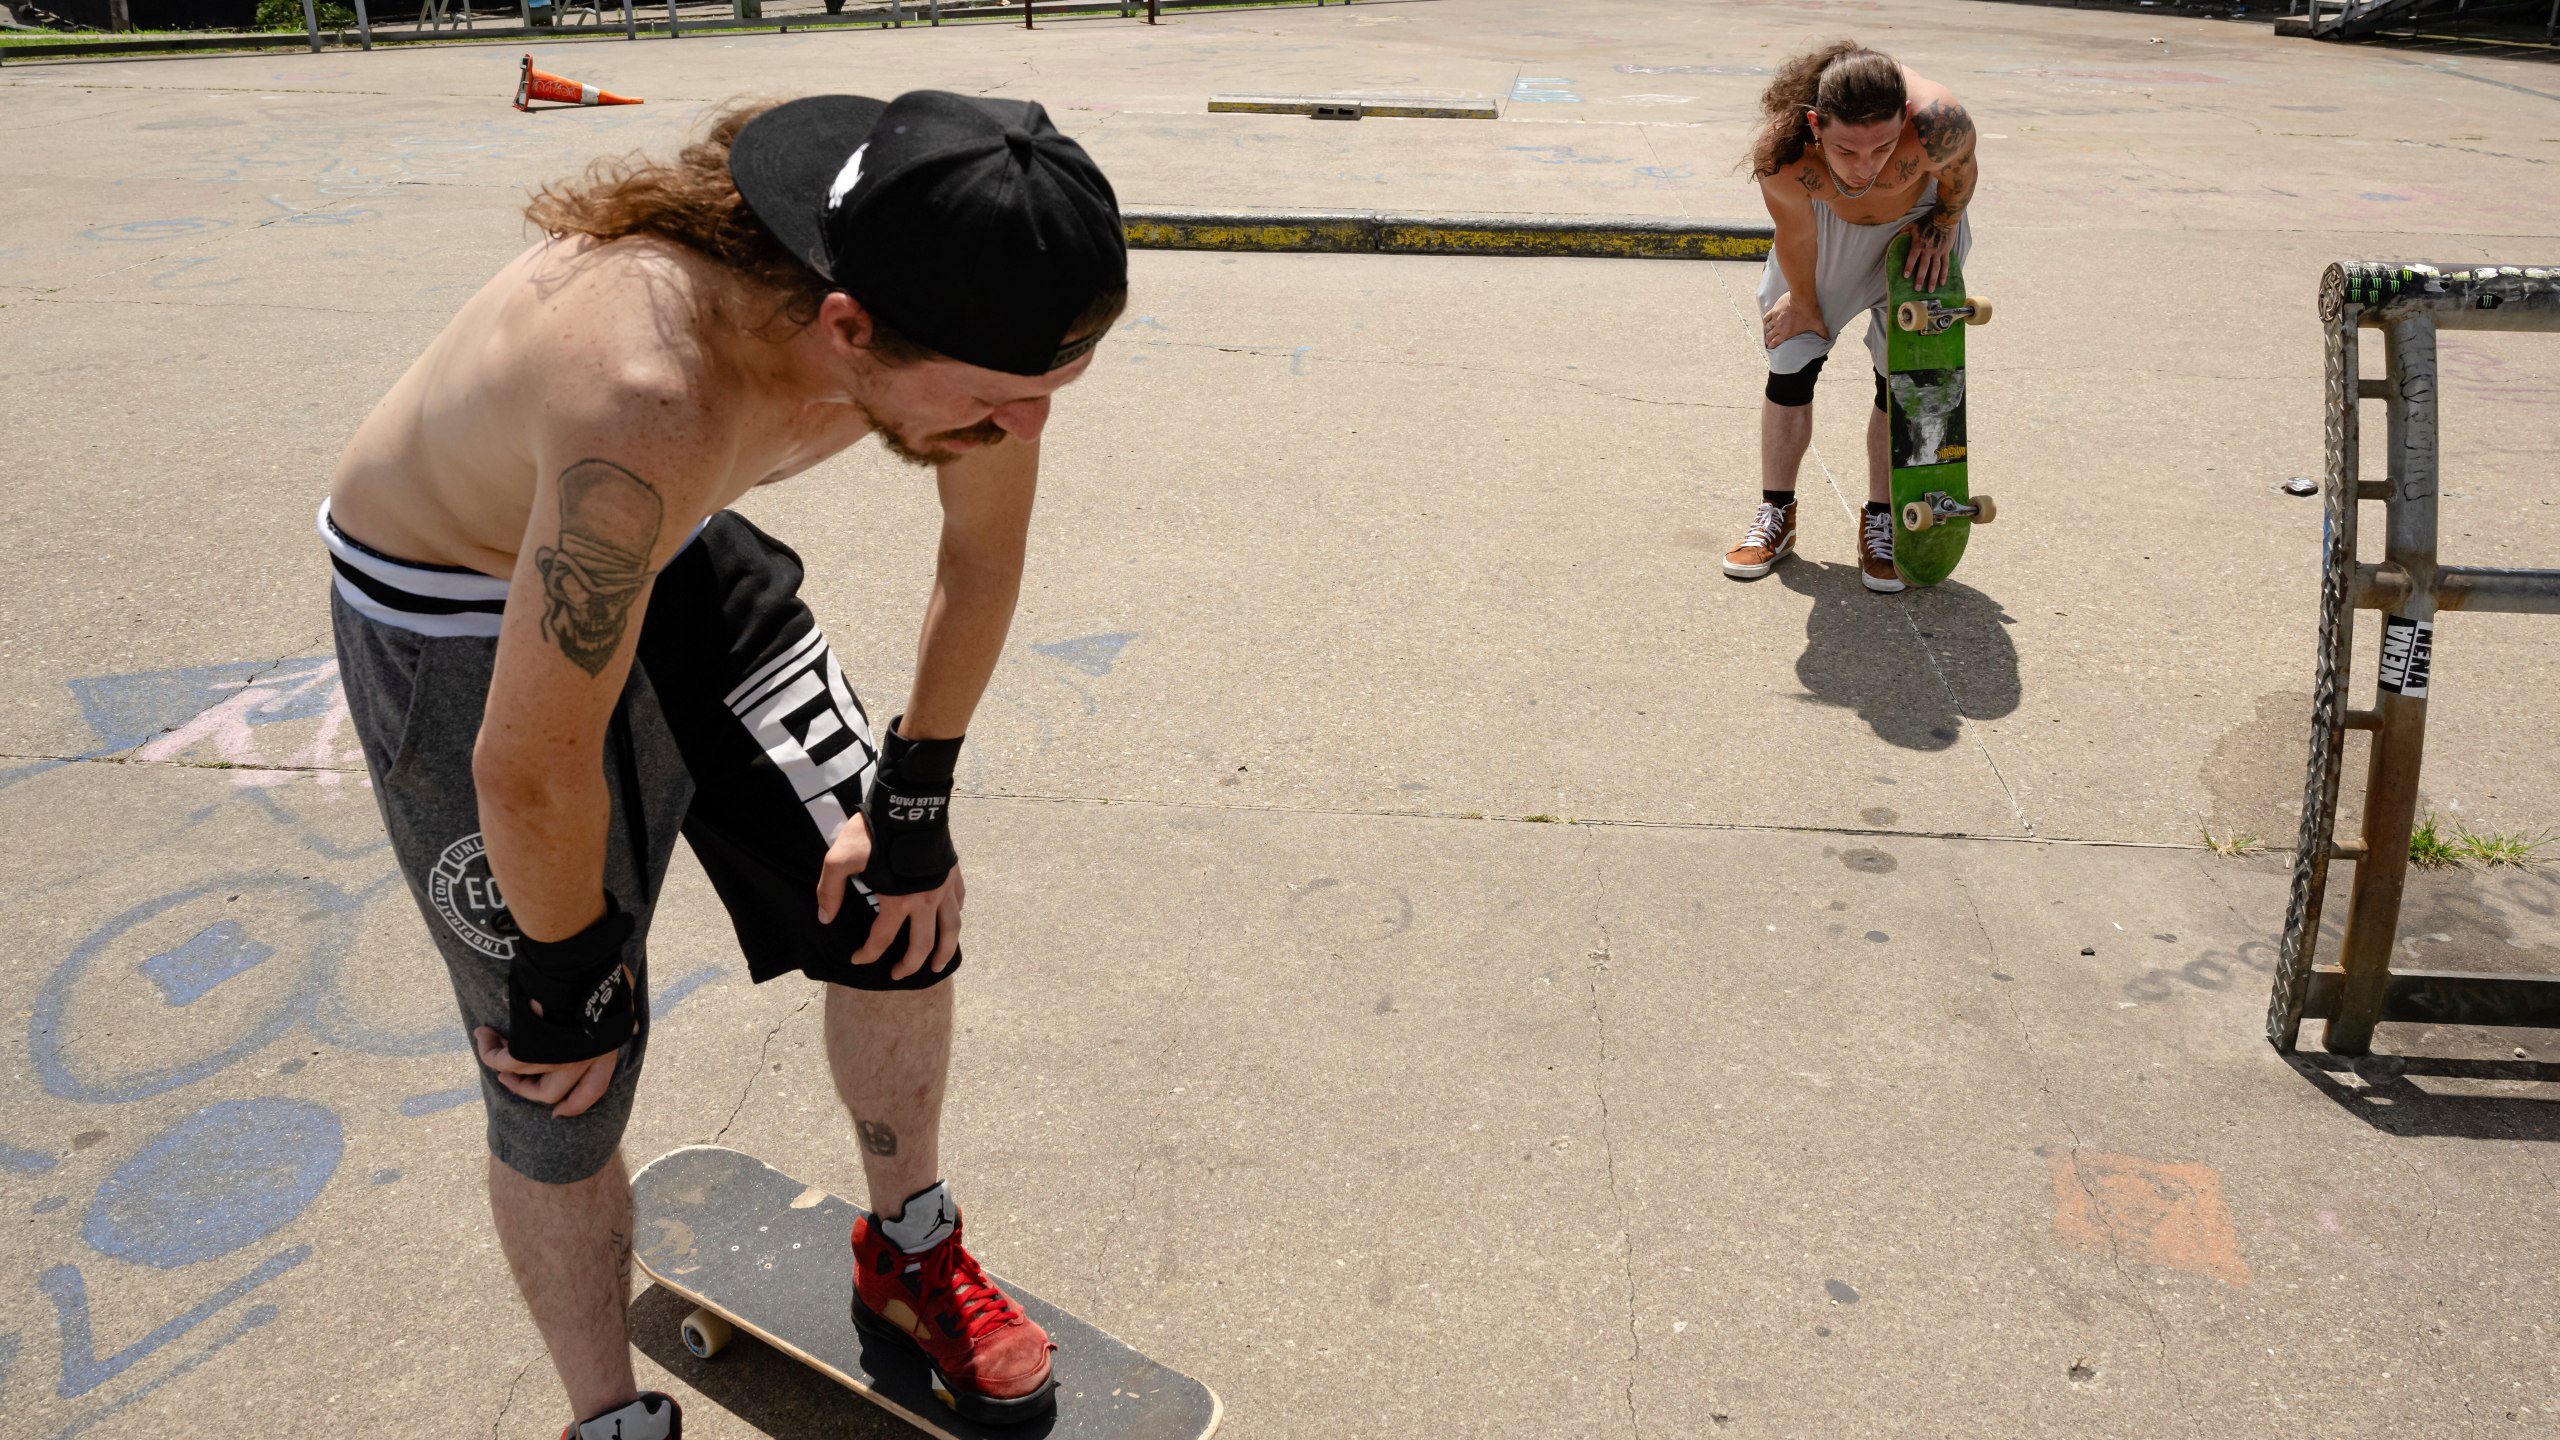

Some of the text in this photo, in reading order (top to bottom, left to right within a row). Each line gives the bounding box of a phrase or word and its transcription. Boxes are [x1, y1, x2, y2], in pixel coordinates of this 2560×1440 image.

[2380, 625, 2415, 687] NENA
[2404, 628, 2433, 688] NENA
[888, 794, 947, 807] KILLER PADS
[888, 806, 940, 821] 187
[449, 837, 485, 862] UNL
[464, 877, 506, 910] EC
[434, 875, 502, 954] INSPIRATION
